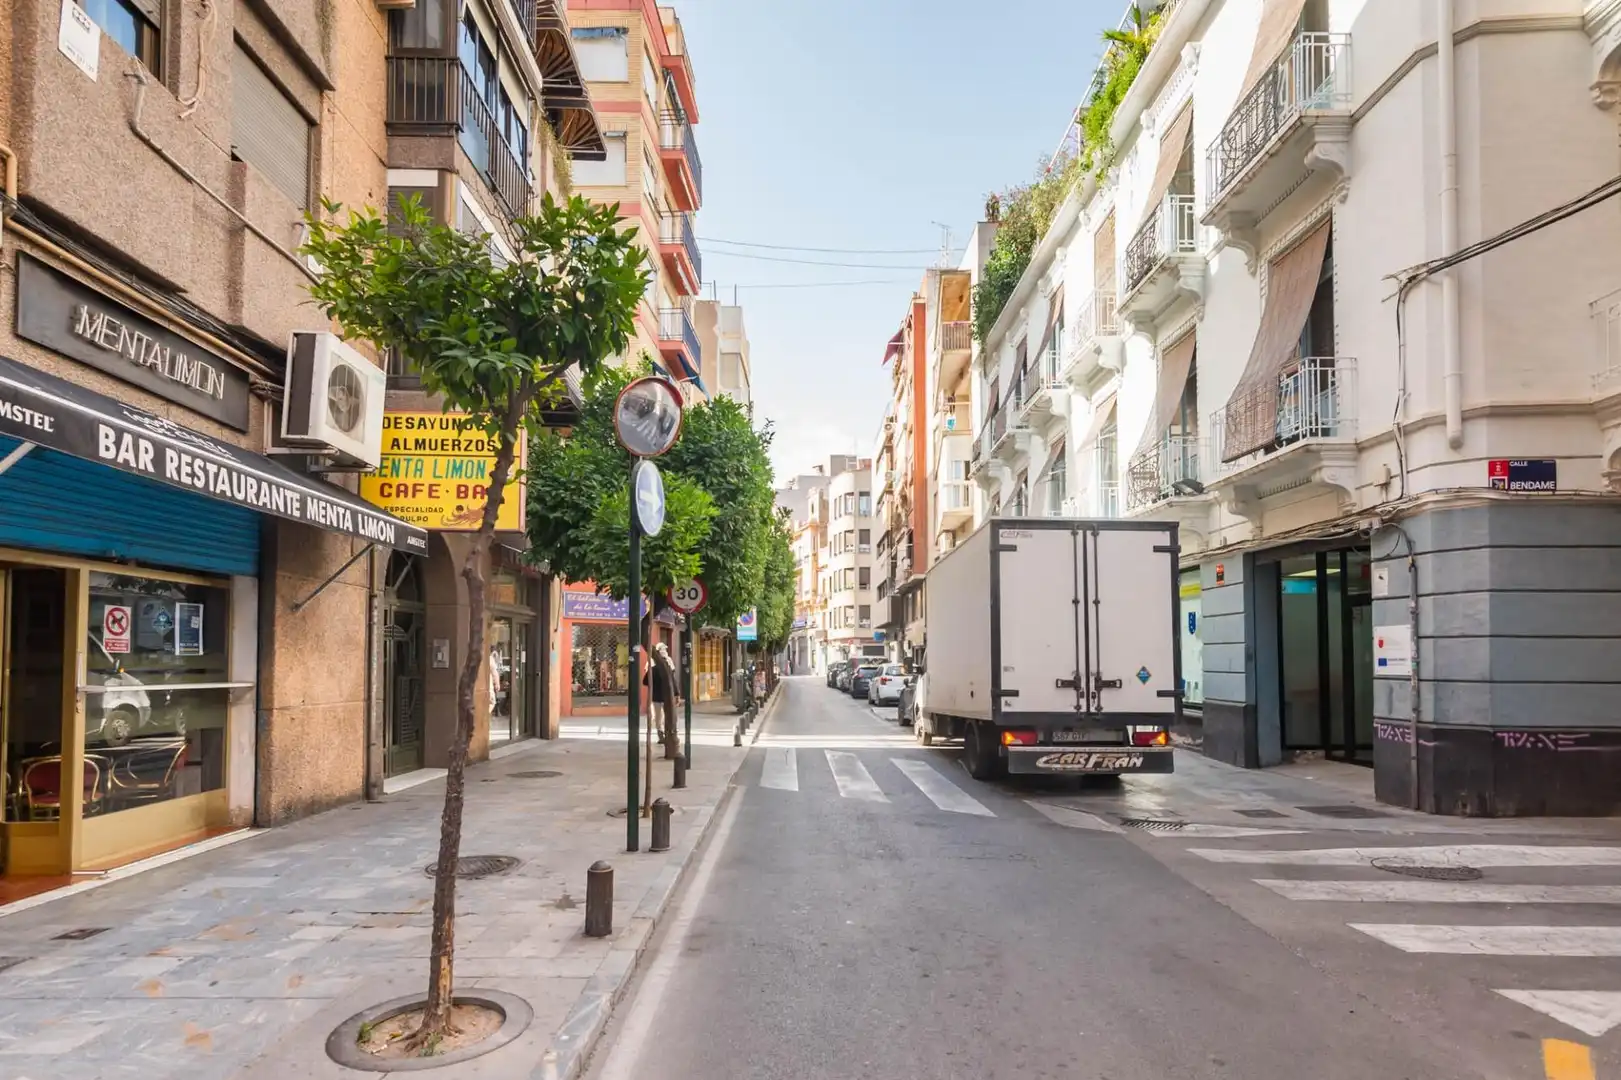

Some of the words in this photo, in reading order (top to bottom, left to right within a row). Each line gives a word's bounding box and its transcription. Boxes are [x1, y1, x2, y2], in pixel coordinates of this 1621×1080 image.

[0, 399, 54, 433] MSTEL
[382, 416, 485, 431] DESAYUN
[390, 437, 496, 452] ALMUERZOS
[363, 456, 425, 479] ENTA
[432, 458, 487, 480] LIMON
[98, 423, 155, 473] BAR
[165, 447, 301, 518] RESTAURANTE
[306, 496, 354, 532] MENTA
[357, 513, 395, 545] LIMON
[379, 482, 441, 499] CAFE
[456, 484, 488, 500] BA
[1510, 480, 1556, 490] BENDAME
[676, 587, 698, 600] 30
